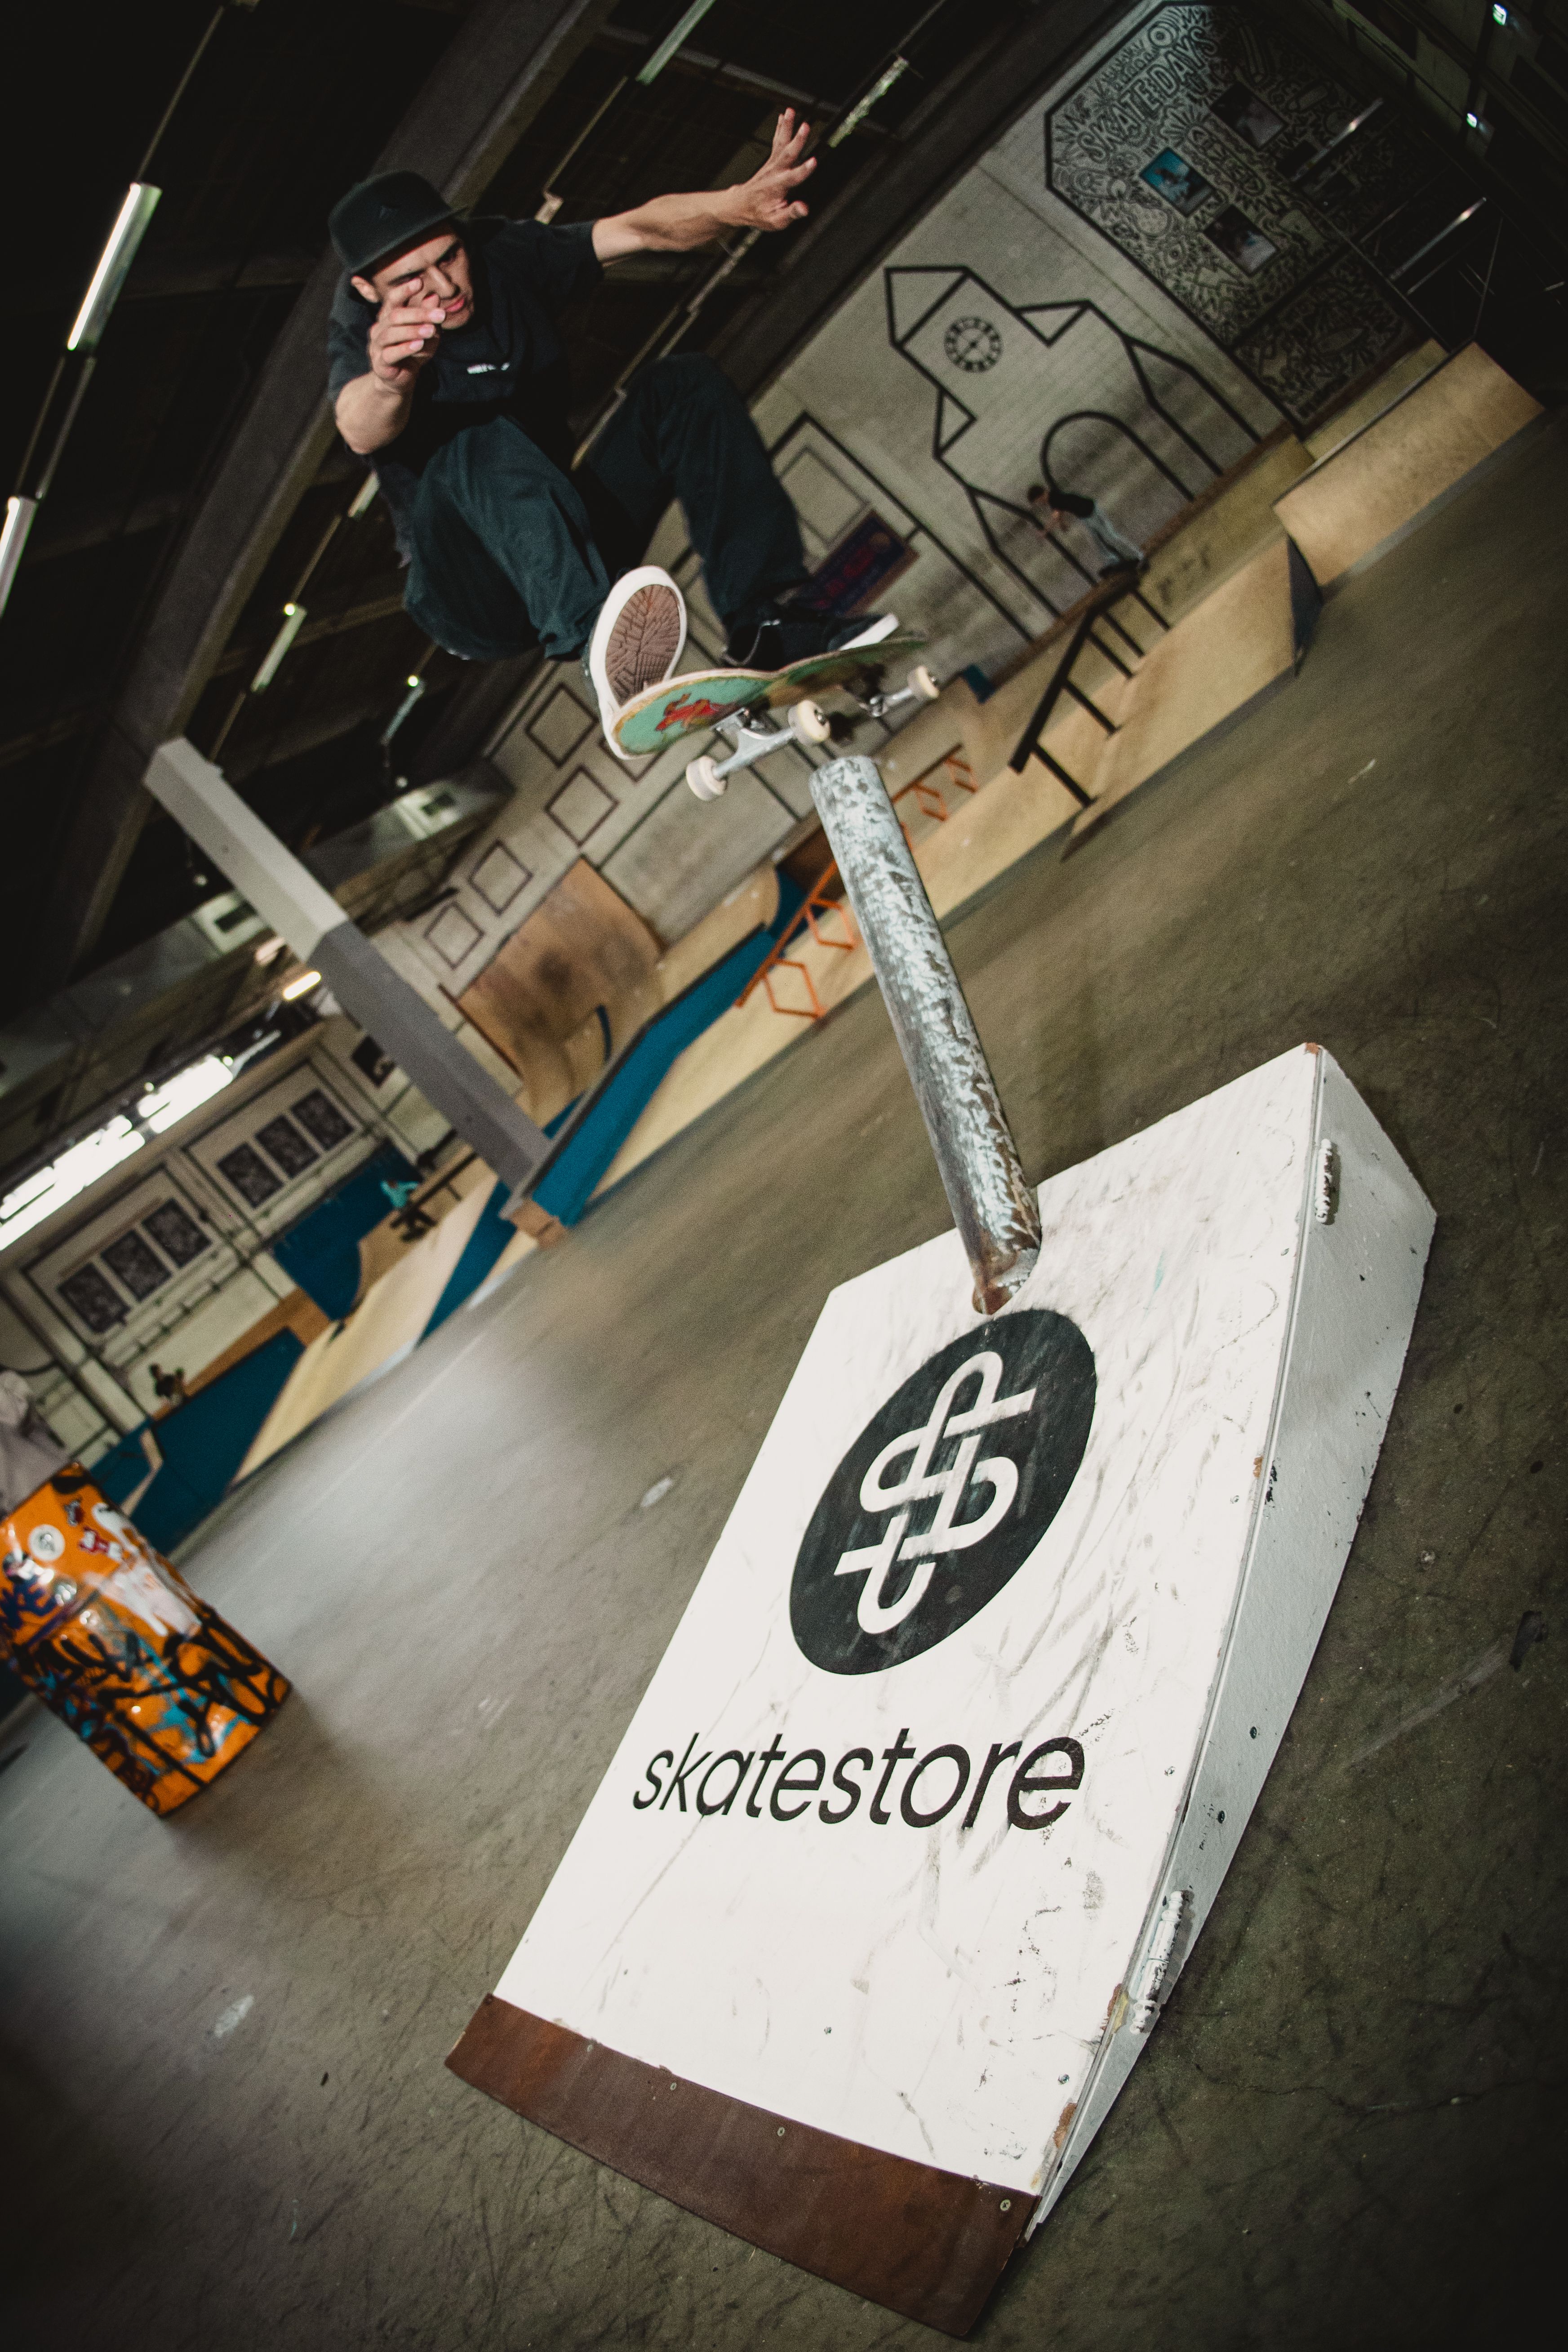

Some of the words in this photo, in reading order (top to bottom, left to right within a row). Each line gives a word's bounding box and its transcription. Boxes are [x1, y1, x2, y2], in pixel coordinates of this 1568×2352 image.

[1078, 77, 1163, 164] SKATE
[1147, 27, 1219, 98] DAYS
[633, 1728, 1085, 1830] skatestore
